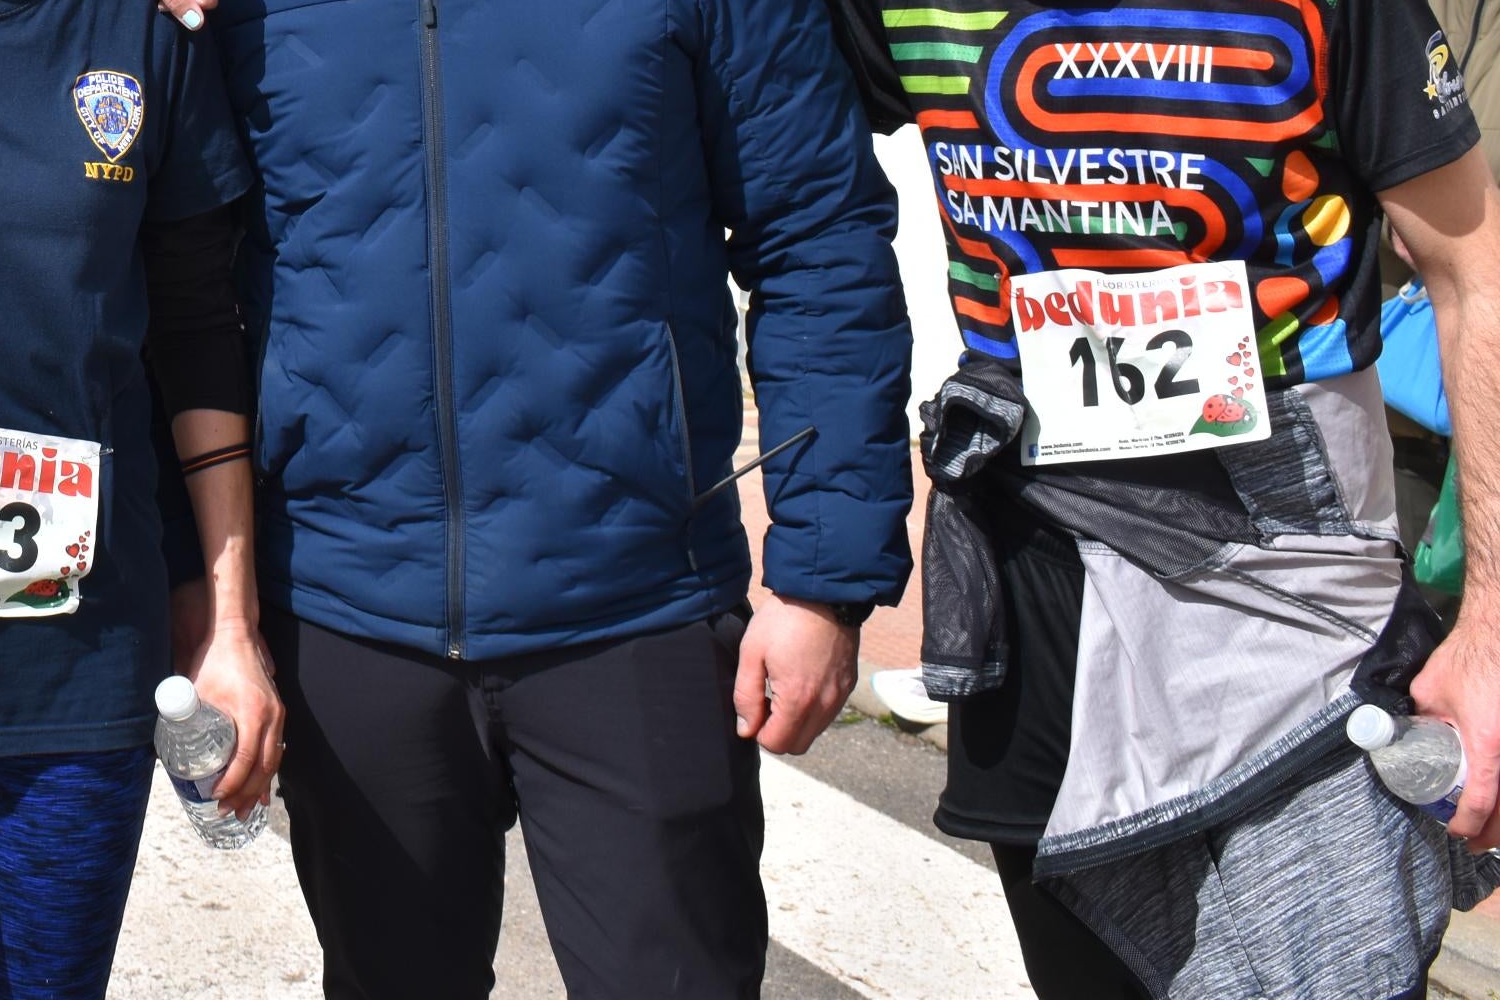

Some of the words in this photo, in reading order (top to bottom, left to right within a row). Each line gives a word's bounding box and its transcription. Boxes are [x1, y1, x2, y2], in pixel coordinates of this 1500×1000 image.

[88, 74, 125, 87] POLICE
[1053, 42, 1213, 84] XXXVIII
[77, 83, 140, 101] DEPARTMENT
[80, 106, 97, 129] CITY
[93, 130, 106, 145] OF
[117, 132, 134, 152] NEW
[130, 105, 142, 131] YORK
[84, 161, 134, 182] NYPD
[934, 141, 982, 179] SAN
[993, 146, 1206, 191] SILVESTRE
[946, 188, 1176, 237] SAMANTINA
[1016, 276, 1244, 332] bedunia
[1069, 329, 1201, 407] 162
